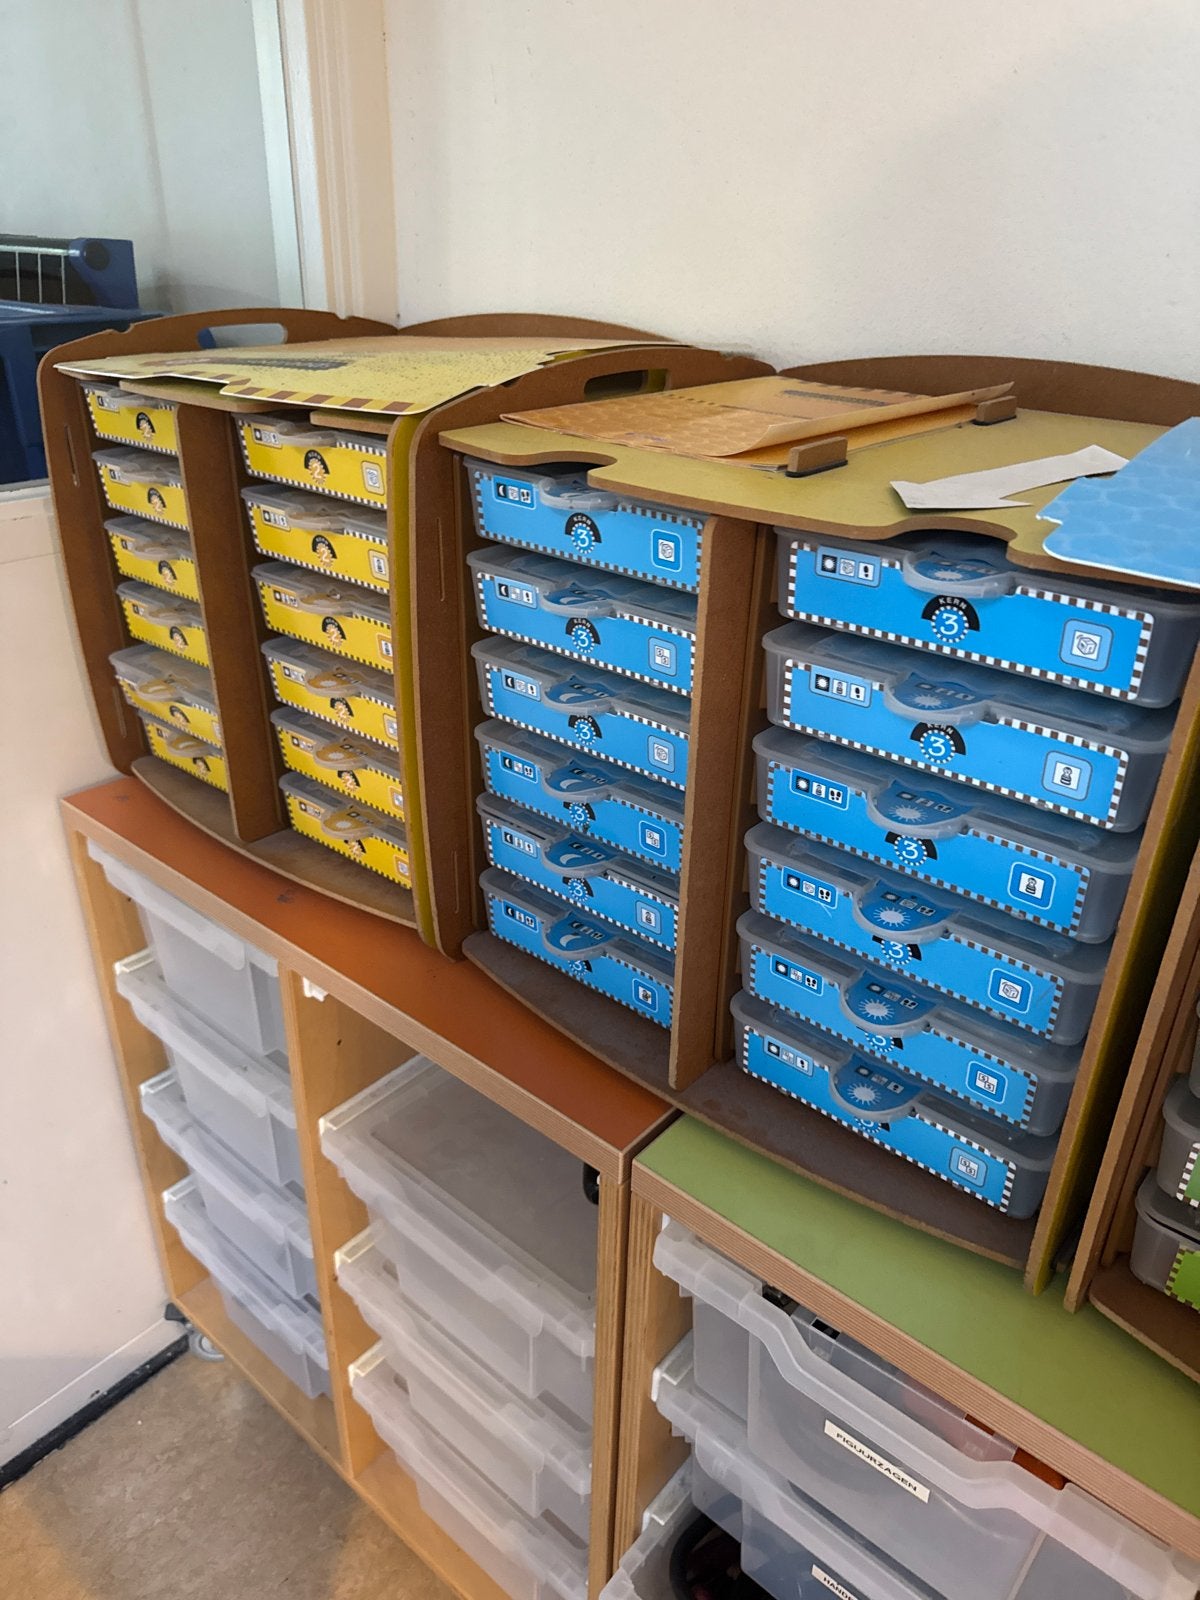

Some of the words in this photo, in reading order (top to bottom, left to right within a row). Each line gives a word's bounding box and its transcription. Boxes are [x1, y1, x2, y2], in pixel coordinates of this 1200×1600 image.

[313, 463, 322, 479] 2
[577, 529, 590, 547] 3
[320, 547, 330, 562] 2
[939, 596, 968, 610] KERN
[940, 612, 959, 635] 3
[577, 630, 589, 647] 3
[579, 723, 591, 740] 3
[928, 736, 946, 757] 3
[574, 805, 585, 821] 3
[902, 840, 919, 859] 3
[573, 882, 583, 896] 3
[888, 940, 904, 959] 3
[836, 1432, 918, 1492] FIGUURZAGEN
